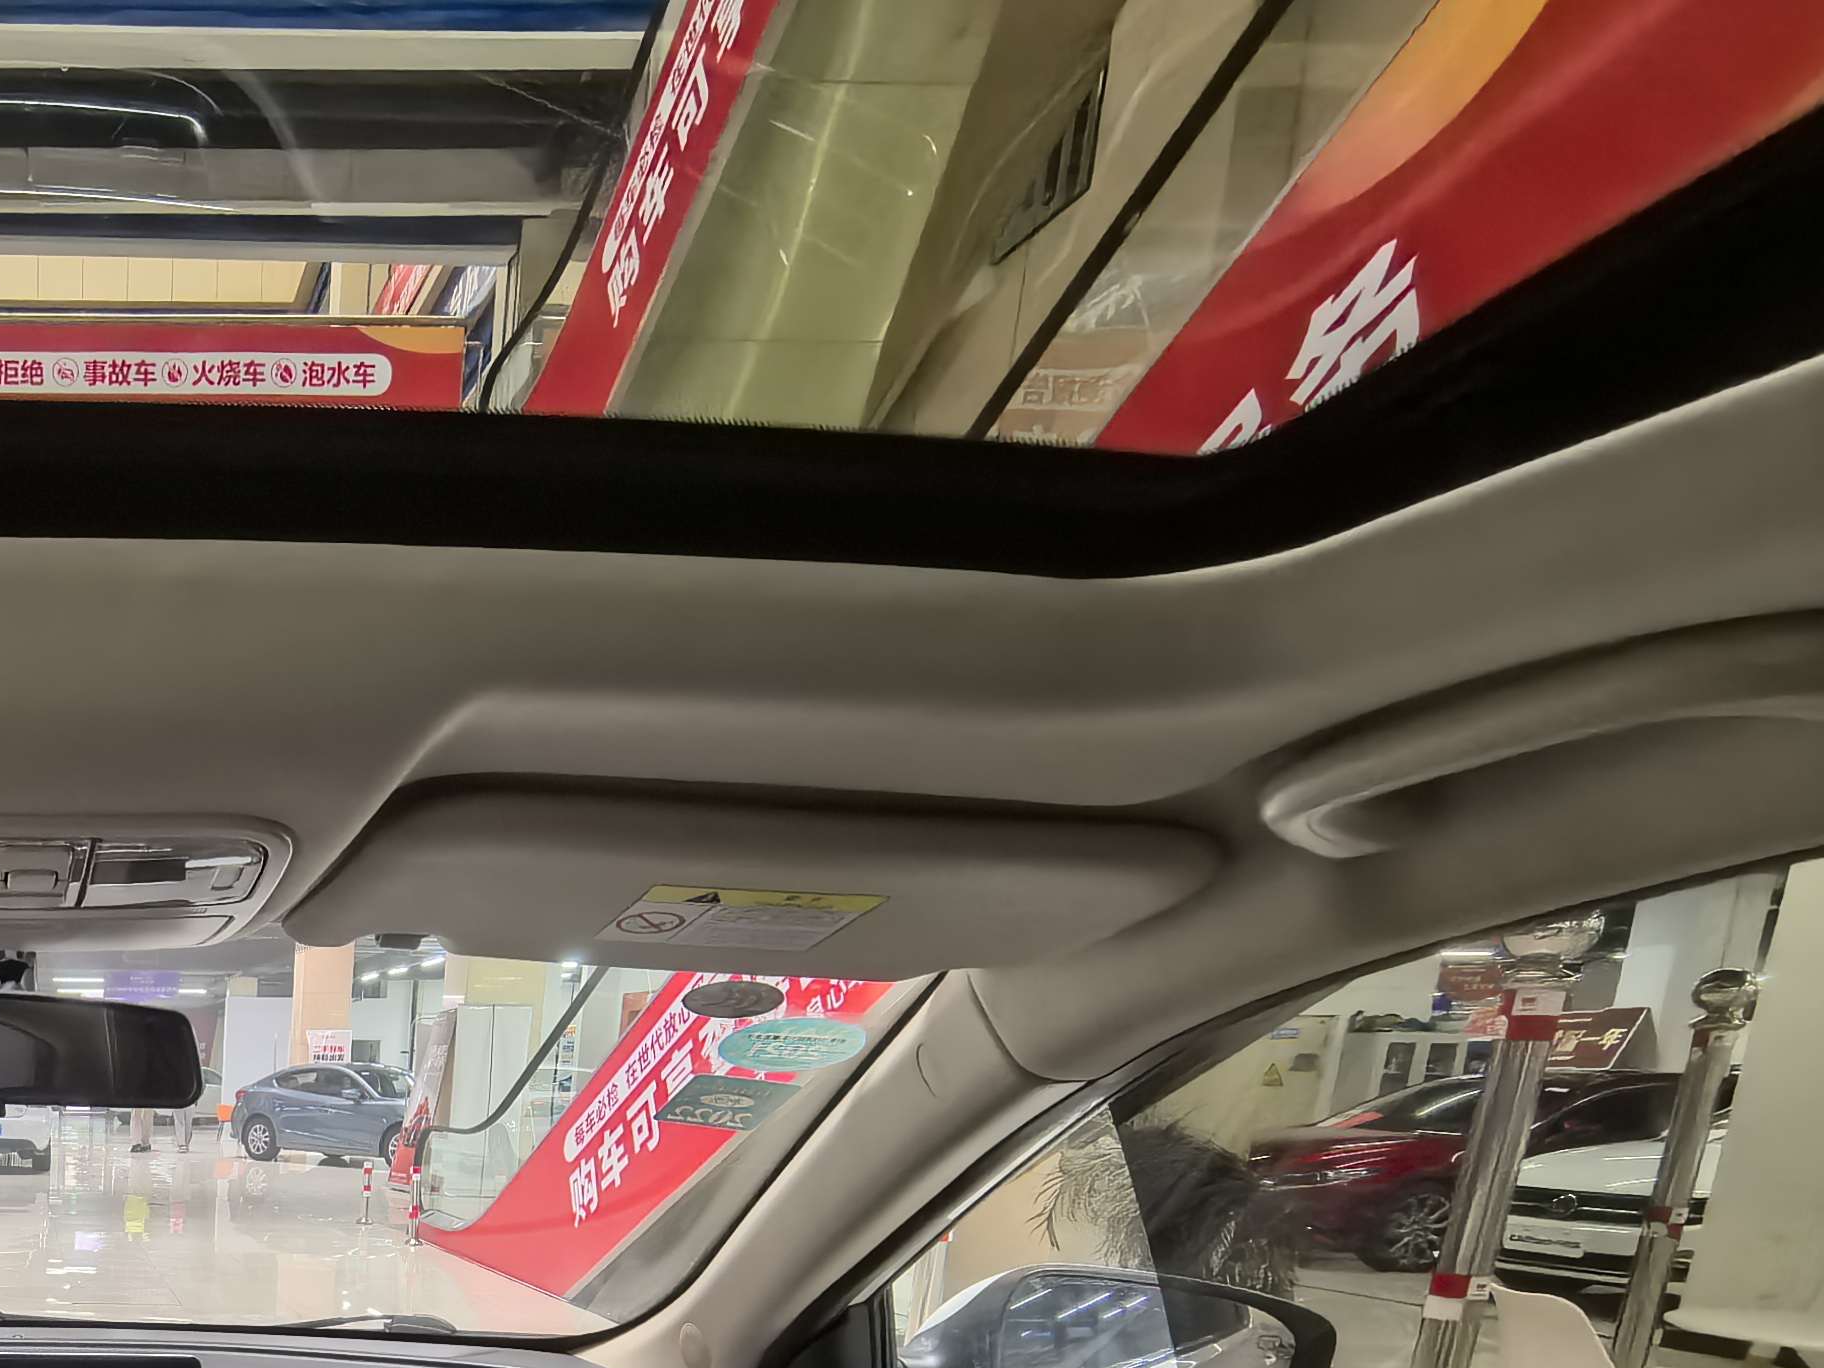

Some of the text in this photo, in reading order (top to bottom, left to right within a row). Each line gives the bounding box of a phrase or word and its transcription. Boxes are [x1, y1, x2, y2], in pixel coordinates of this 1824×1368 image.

[83, 356, 157, 387] 事故车
[192, 357, 266, 388] 火烧车
[302, 359, 376, 389] 泡水车
[575, 1083, 620, 1147] 每车必检
